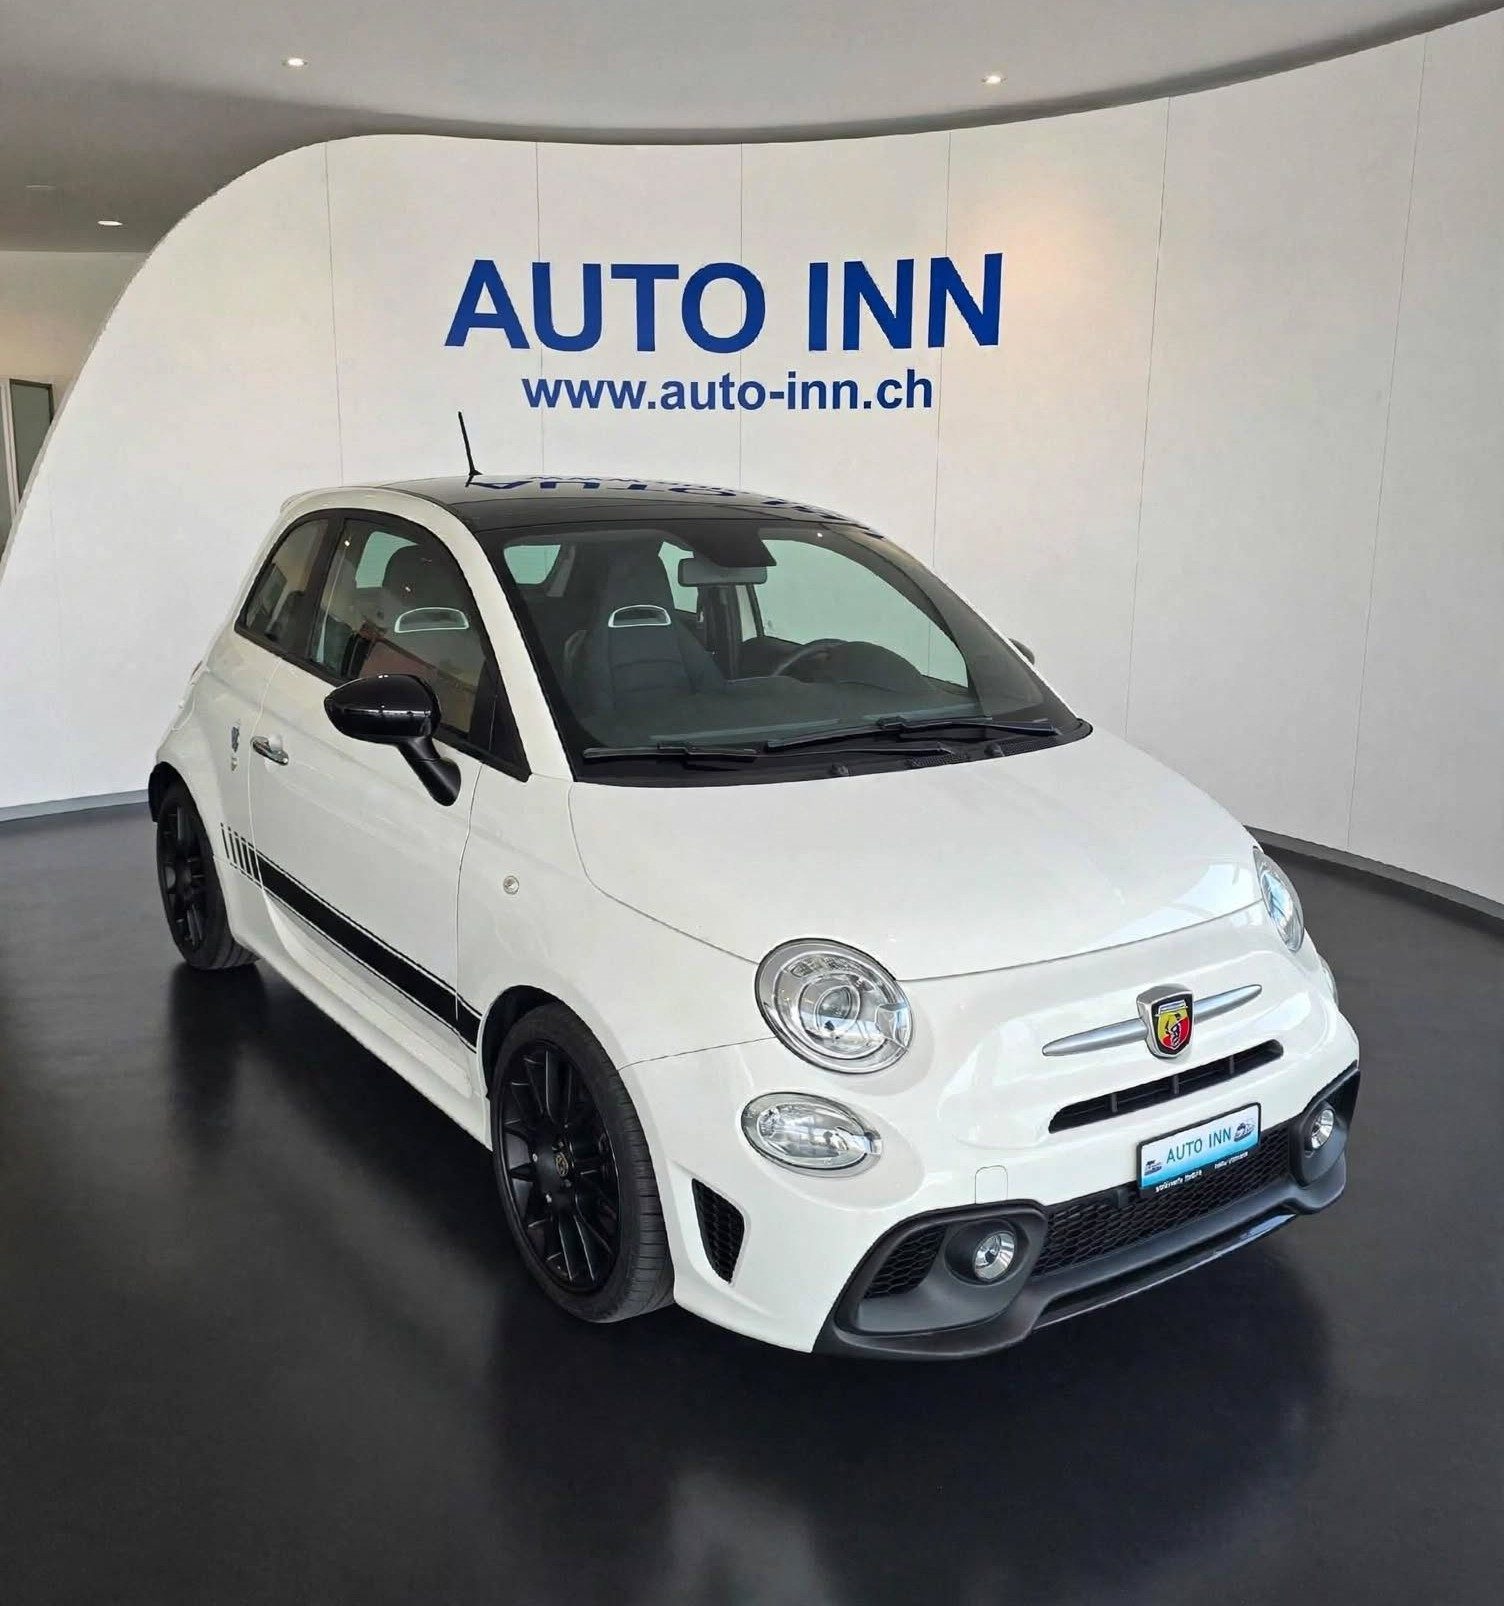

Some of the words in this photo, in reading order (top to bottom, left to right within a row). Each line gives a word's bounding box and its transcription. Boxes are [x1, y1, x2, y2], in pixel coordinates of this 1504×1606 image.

[445, 259, 766, 353] AUTO
[808, 253, 1003, 351] INN
[522, 369, 933, 410] www.auto-inn.ch
[1166, 1138, 1203, 1164] AUTO
[1208, 1127, 1232, 1148] INN
